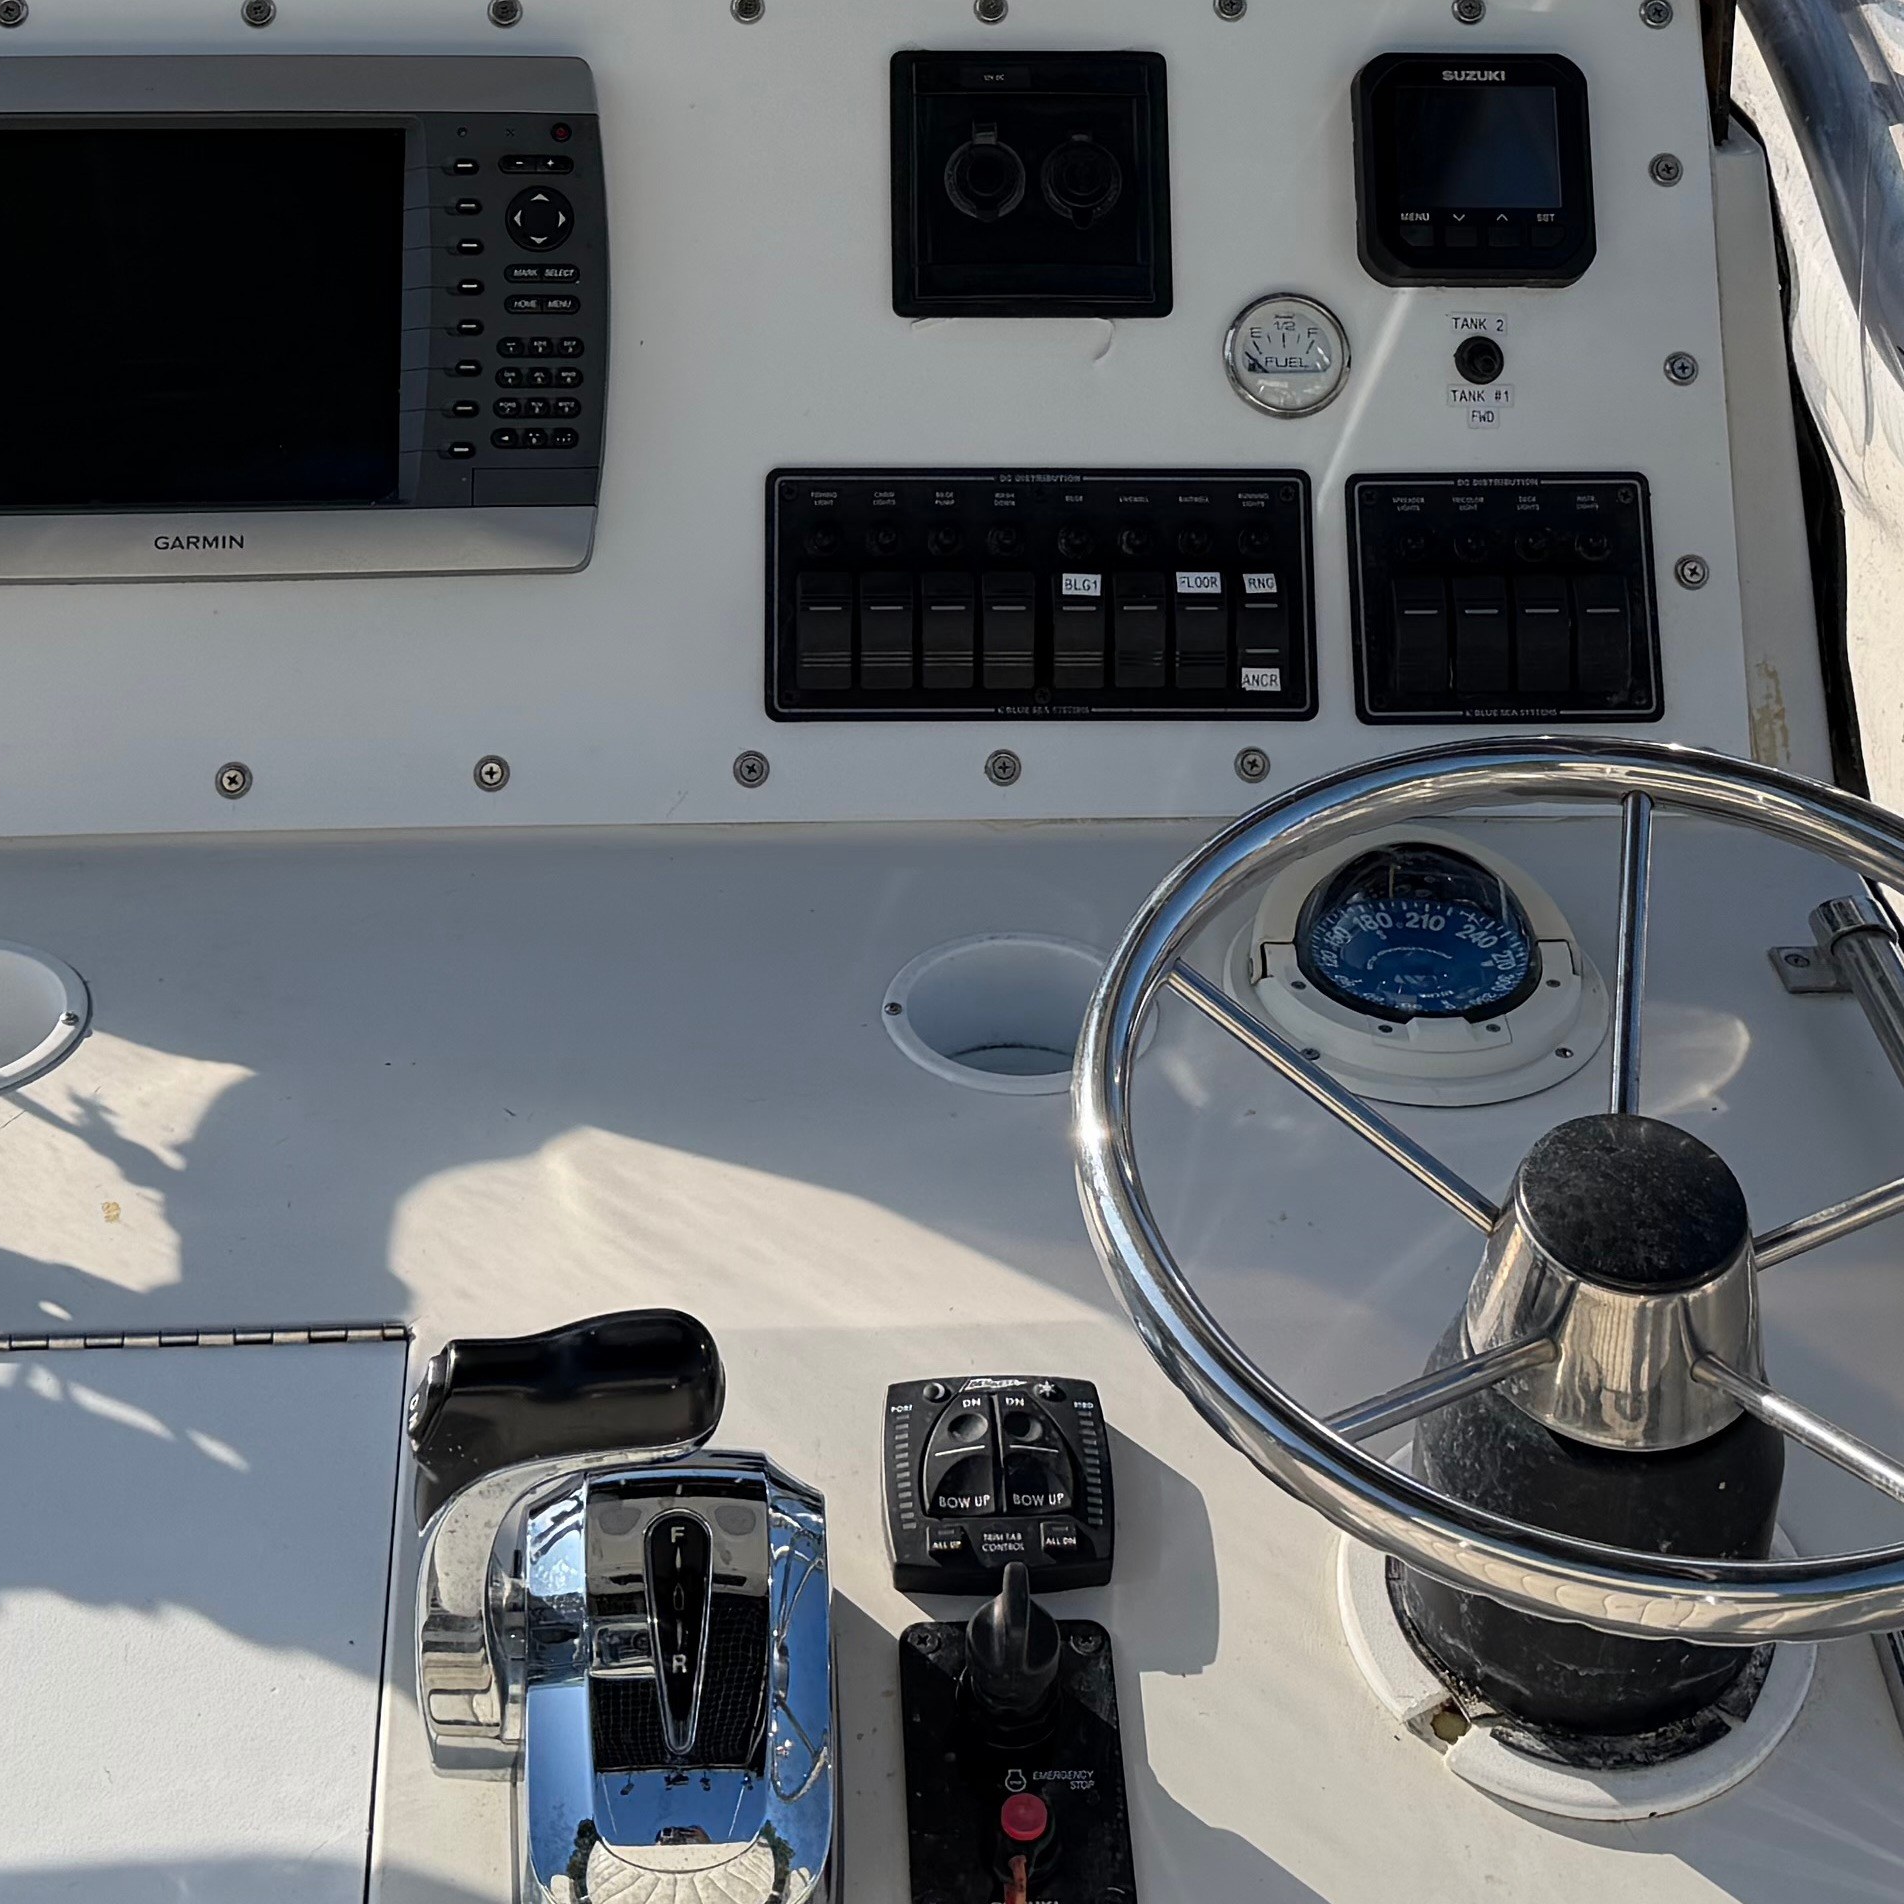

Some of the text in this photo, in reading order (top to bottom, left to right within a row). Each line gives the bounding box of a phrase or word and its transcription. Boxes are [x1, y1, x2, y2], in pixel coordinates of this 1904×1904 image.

[1441, 70, 1506, 82] SUZUKI
[1400, 212, 1430, 222] MENU
[543, 269, 575, 277] SELECT
[513, 300, 537, 308] HOME
[1451, 317, 1505, 332] TANK 2
[1249, 327, 1262, 338] E
[1306, 327, 1320, 338] F
[1264, 356, 1310, 369] FUEL
[1450, 390, 1510, 402] TANK #1
[1471, 410, 1494, 423] FWD
[154, 535, 244, 550] GARMIN
[1248, 578, 1274, 590] RNG
[1242, 673, 1279, 687] ANCR
[1353, 912, 1393, 932] 180
[1405, 912, 1446, 932] 210
[1455, 924, 1498, 949] 240
[1492, 949, 1516, 971] 270
[962, 1398, 981, 1408] DN
[1005, 1397, 1025, 1407] DN
[891, 1404, 913, 1414] PORT
[938, 1494, 991, 1509] BOW UP
[1012, 1492, 1065, 1507] BOW UP
[670, 1526, 685, 1544] F
[983, 1533, 1005, 1542] TRIM
[1045, 1536, 1062, 1546] ALL
[932, 1540, 963, 1550] ALL UP
[982, 1542, 1025, 1553] CONTROL
[672, 1653, 687, 1674] R
[1032, 1770, 1094, 1781] EMERGENCY
[1069, 1780, 1095, 1791] STOP
